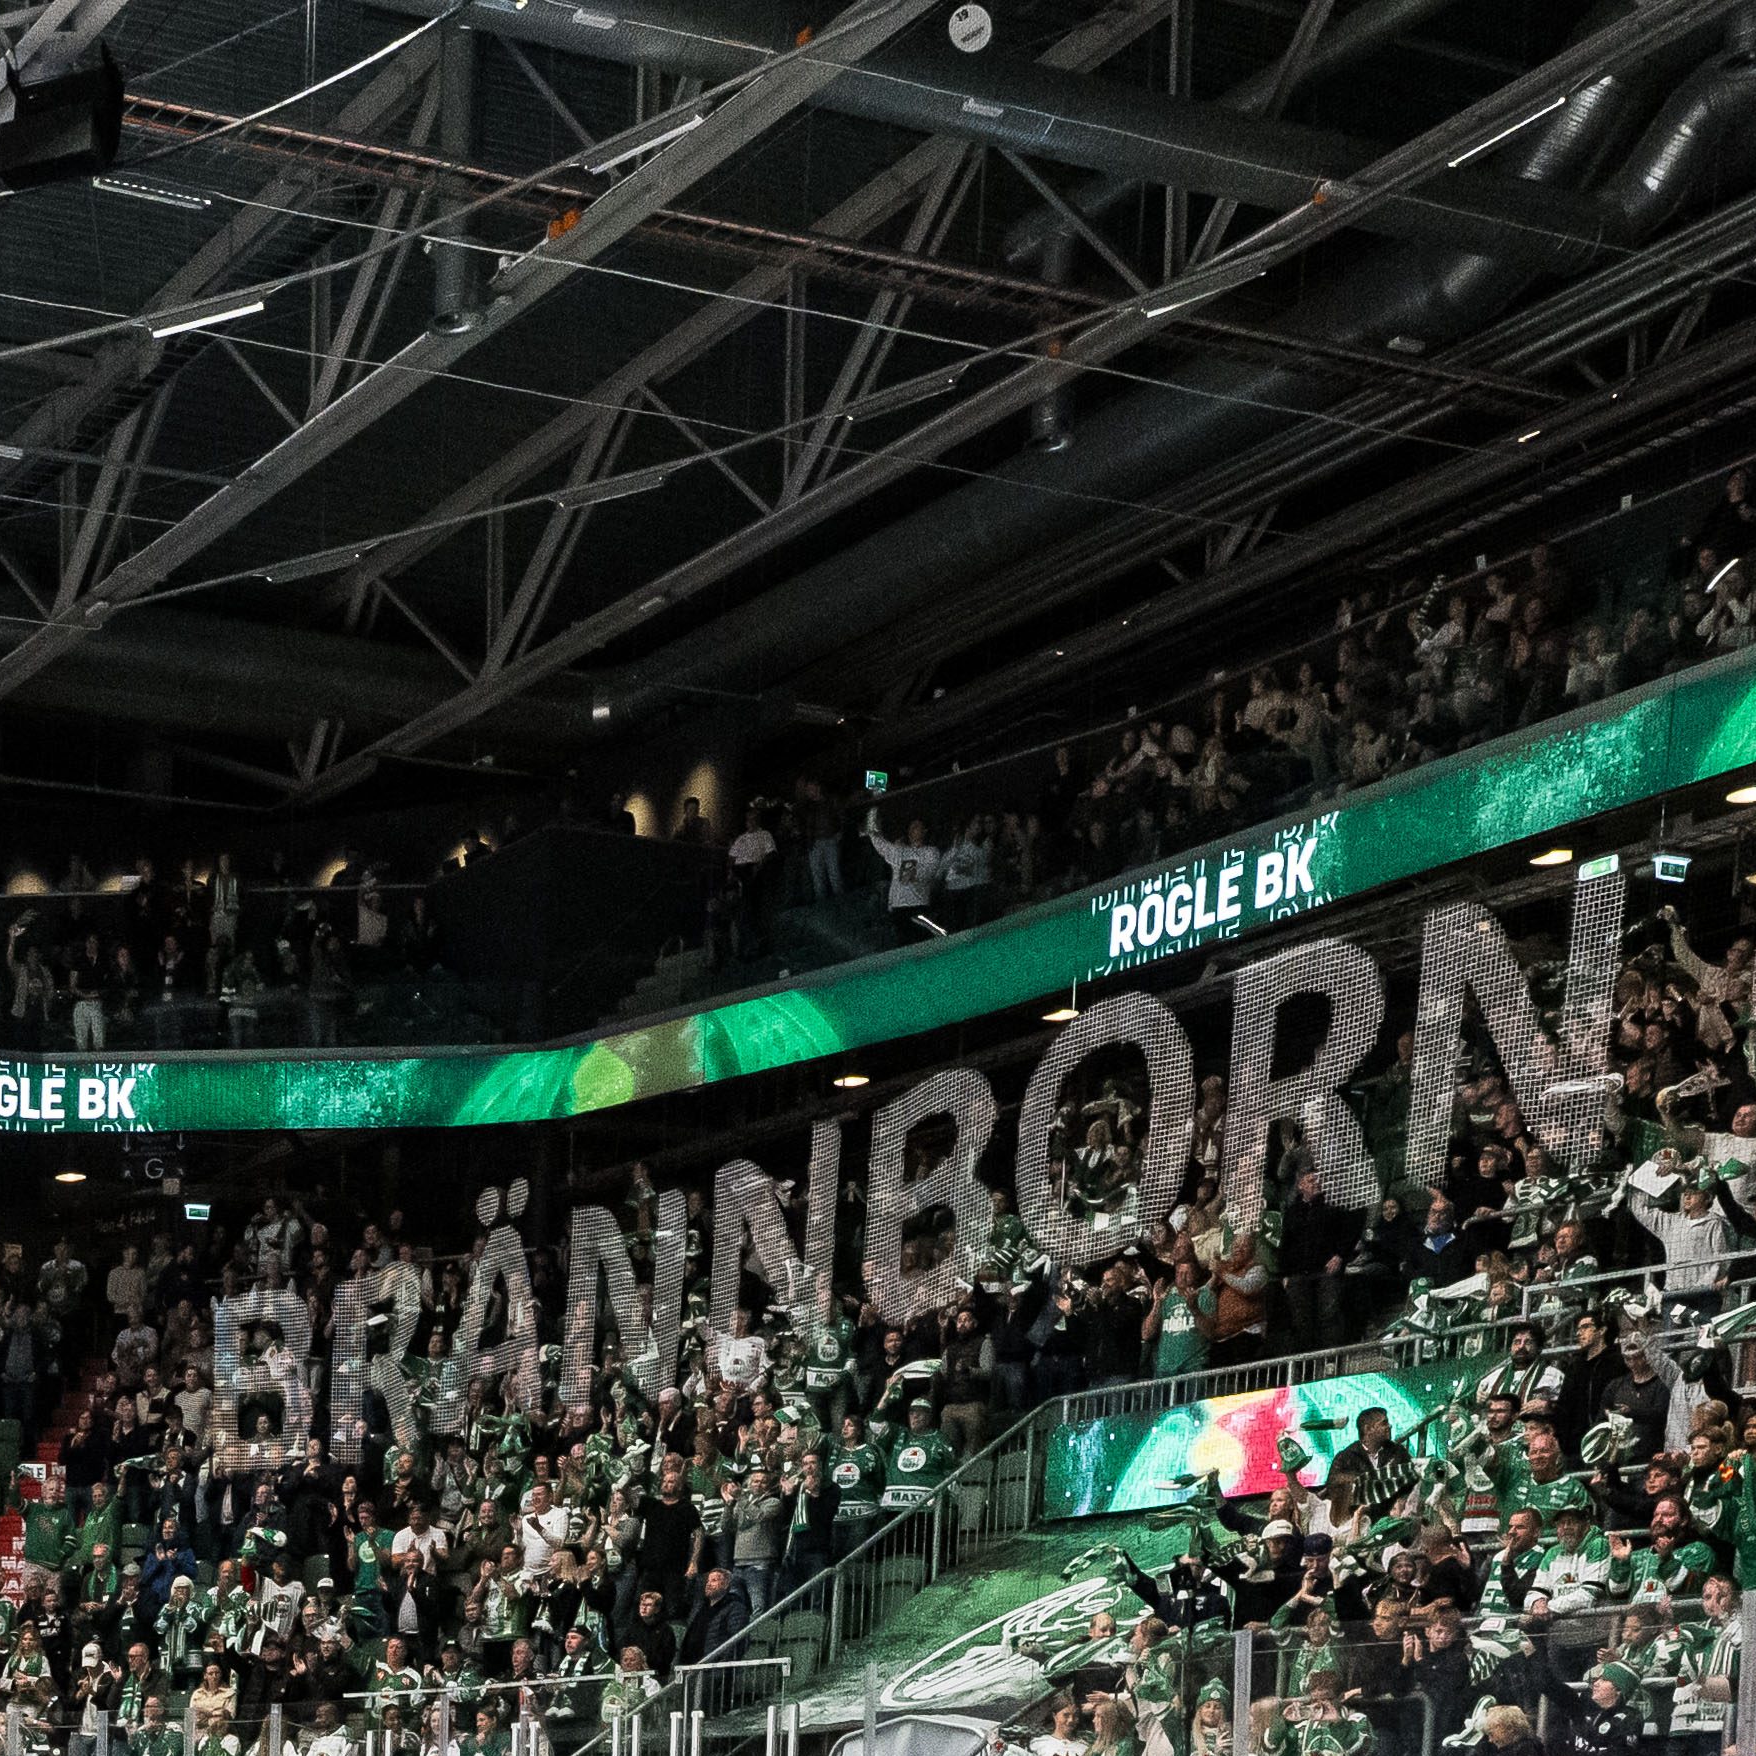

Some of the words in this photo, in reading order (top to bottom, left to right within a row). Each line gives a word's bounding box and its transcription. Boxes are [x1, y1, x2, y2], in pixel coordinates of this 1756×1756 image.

[1109, 862, 1244, 958] RÖGLE
[1254, 837, 1318, 910] BK
[78, 1077, 138, 1121] BK
[211, 870, 1627, 1474] BRÄNNBORN
